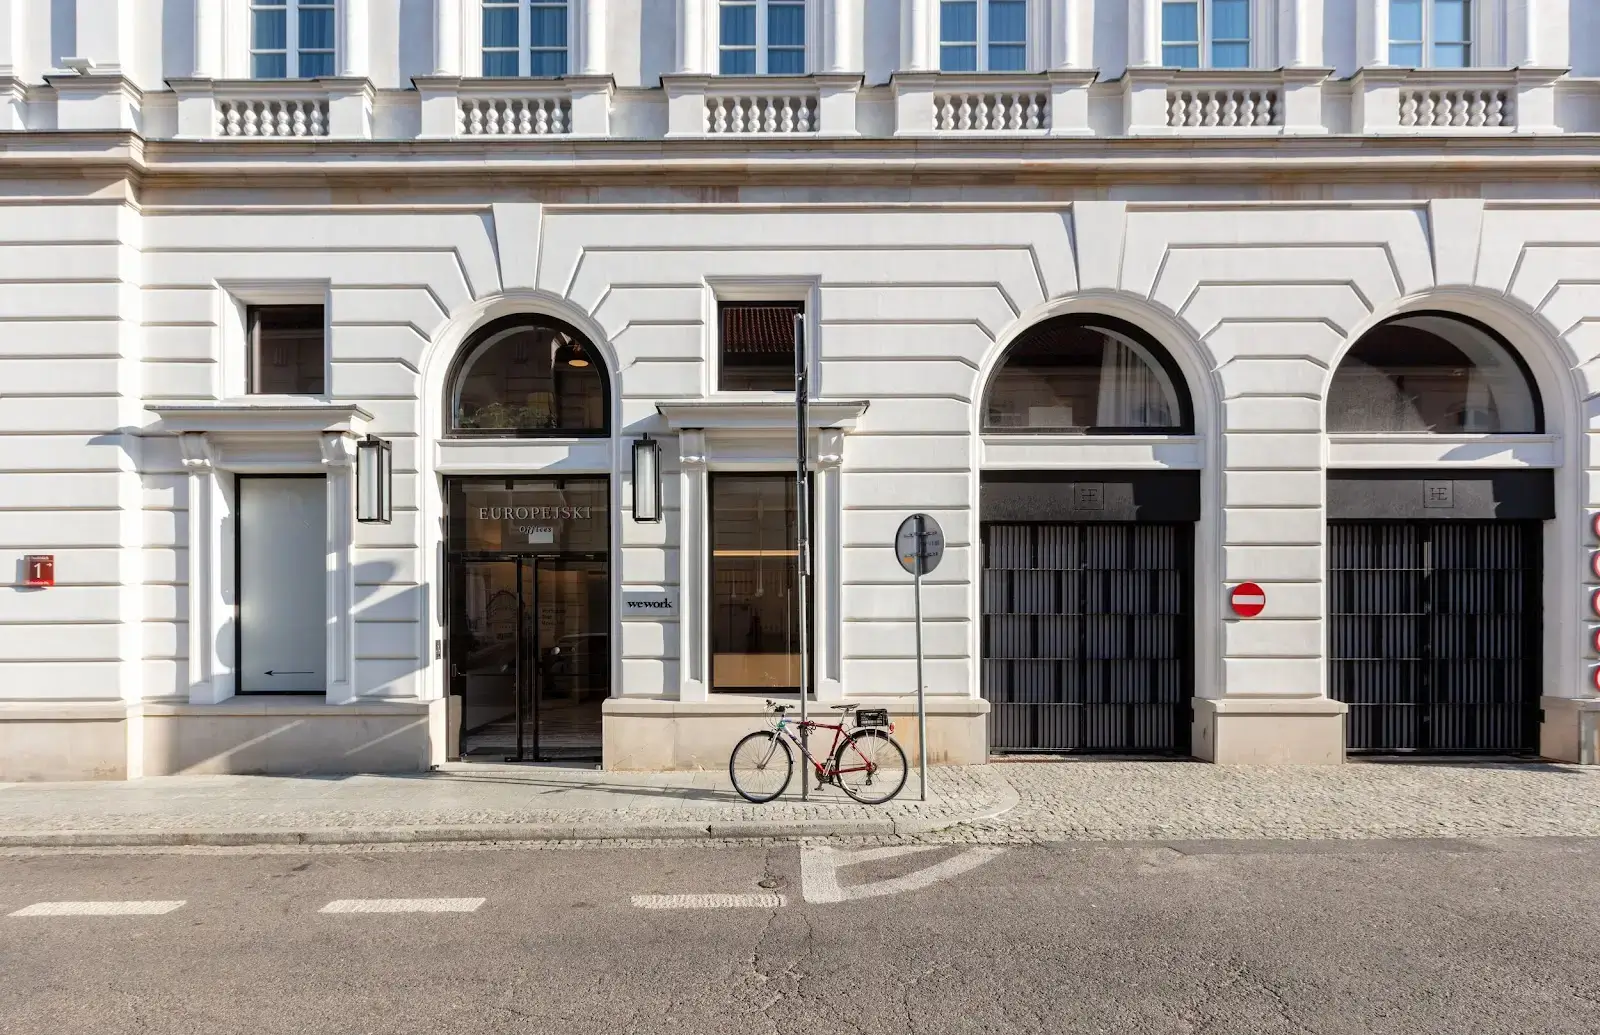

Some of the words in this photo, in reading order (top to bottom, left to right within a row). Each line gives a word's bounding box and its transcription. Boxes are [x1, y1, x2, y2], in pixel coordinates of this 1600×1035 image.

[479, 506, 592, 520] EUROPEJSKI
[519, 525, 552, 535] Offices
[33, 562, 41, 579] 1
[627, 597, 673, 609] wework
